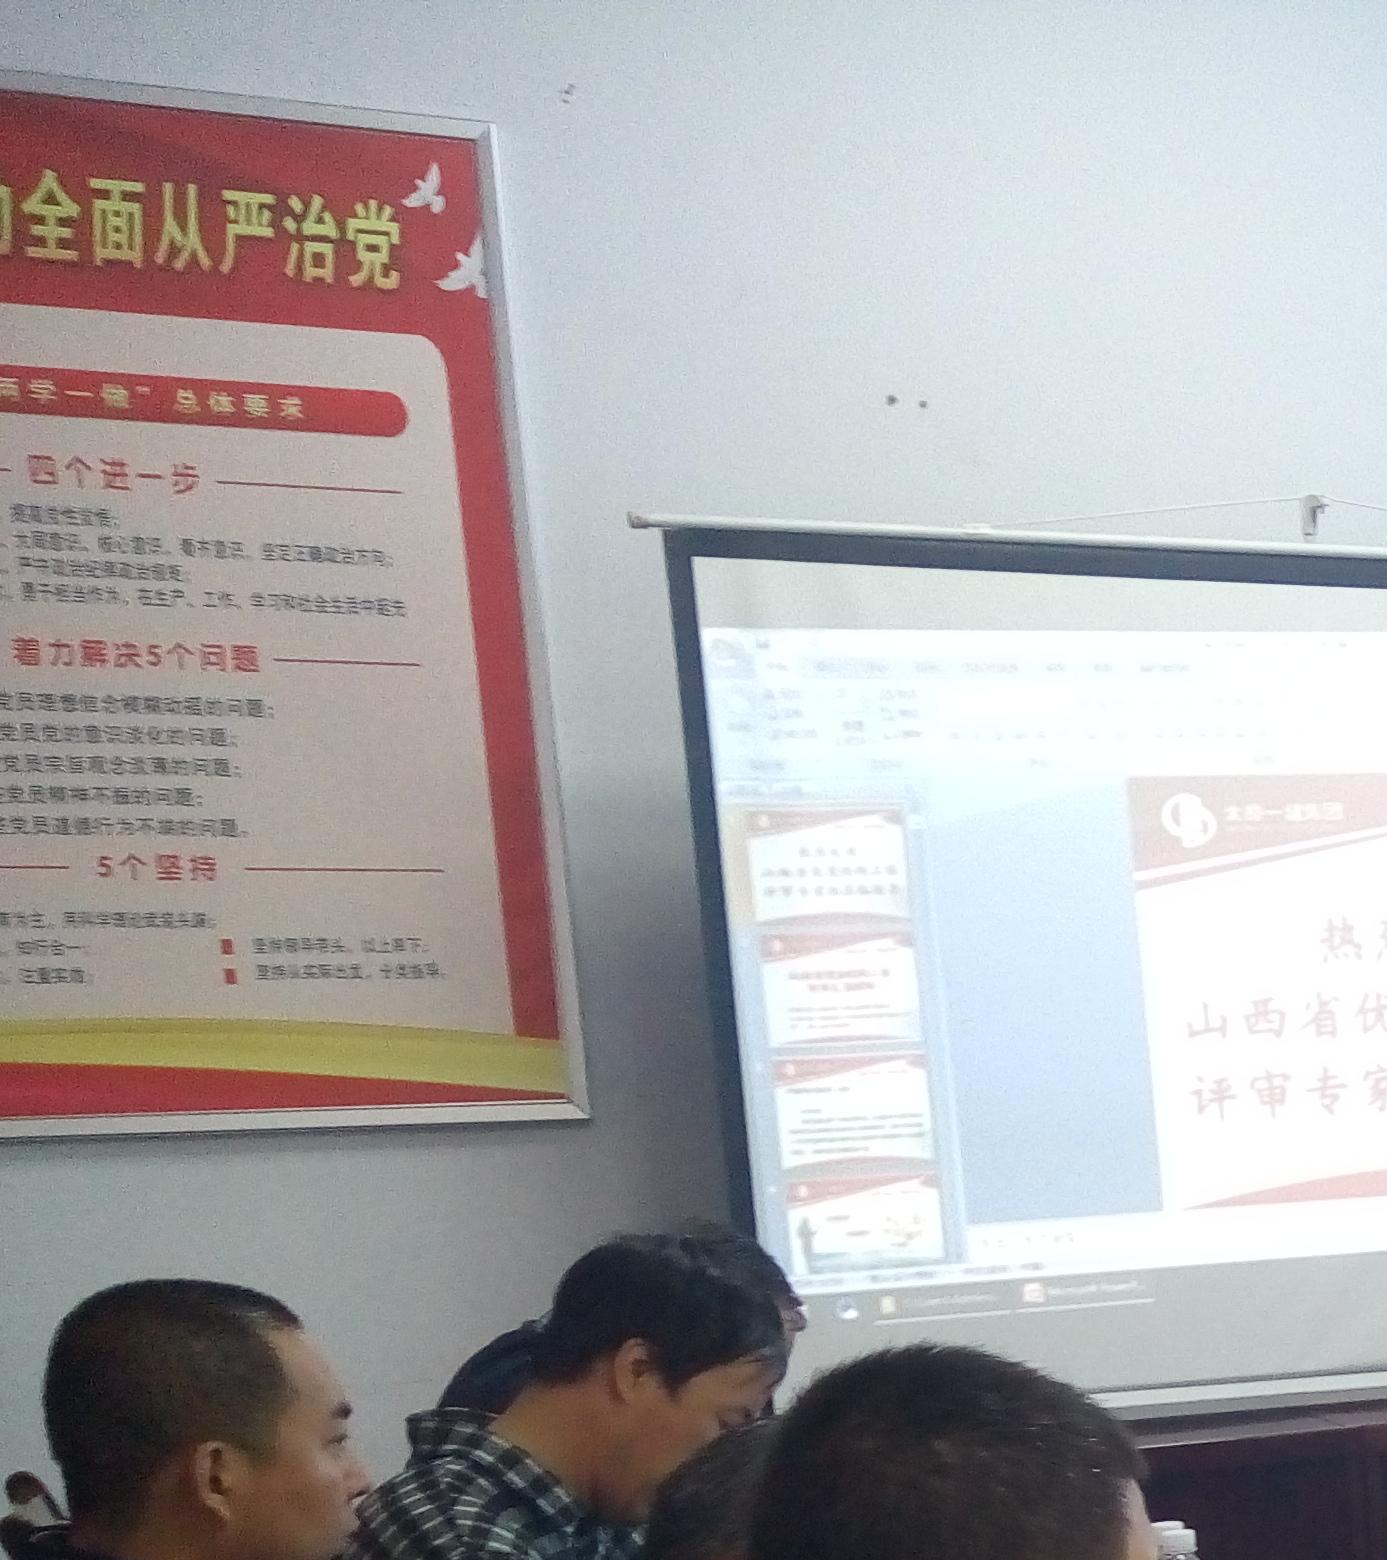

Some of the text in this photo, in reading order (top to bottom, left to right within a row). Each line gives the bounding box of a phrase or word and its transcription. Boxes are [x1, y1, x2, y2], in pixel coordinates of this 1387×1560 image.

[27, 454, 201, 494] 四个进一步
[11, 635, 261, 673] 着力解决5个问题
[95, 854, 219, 882] 5个坚持
